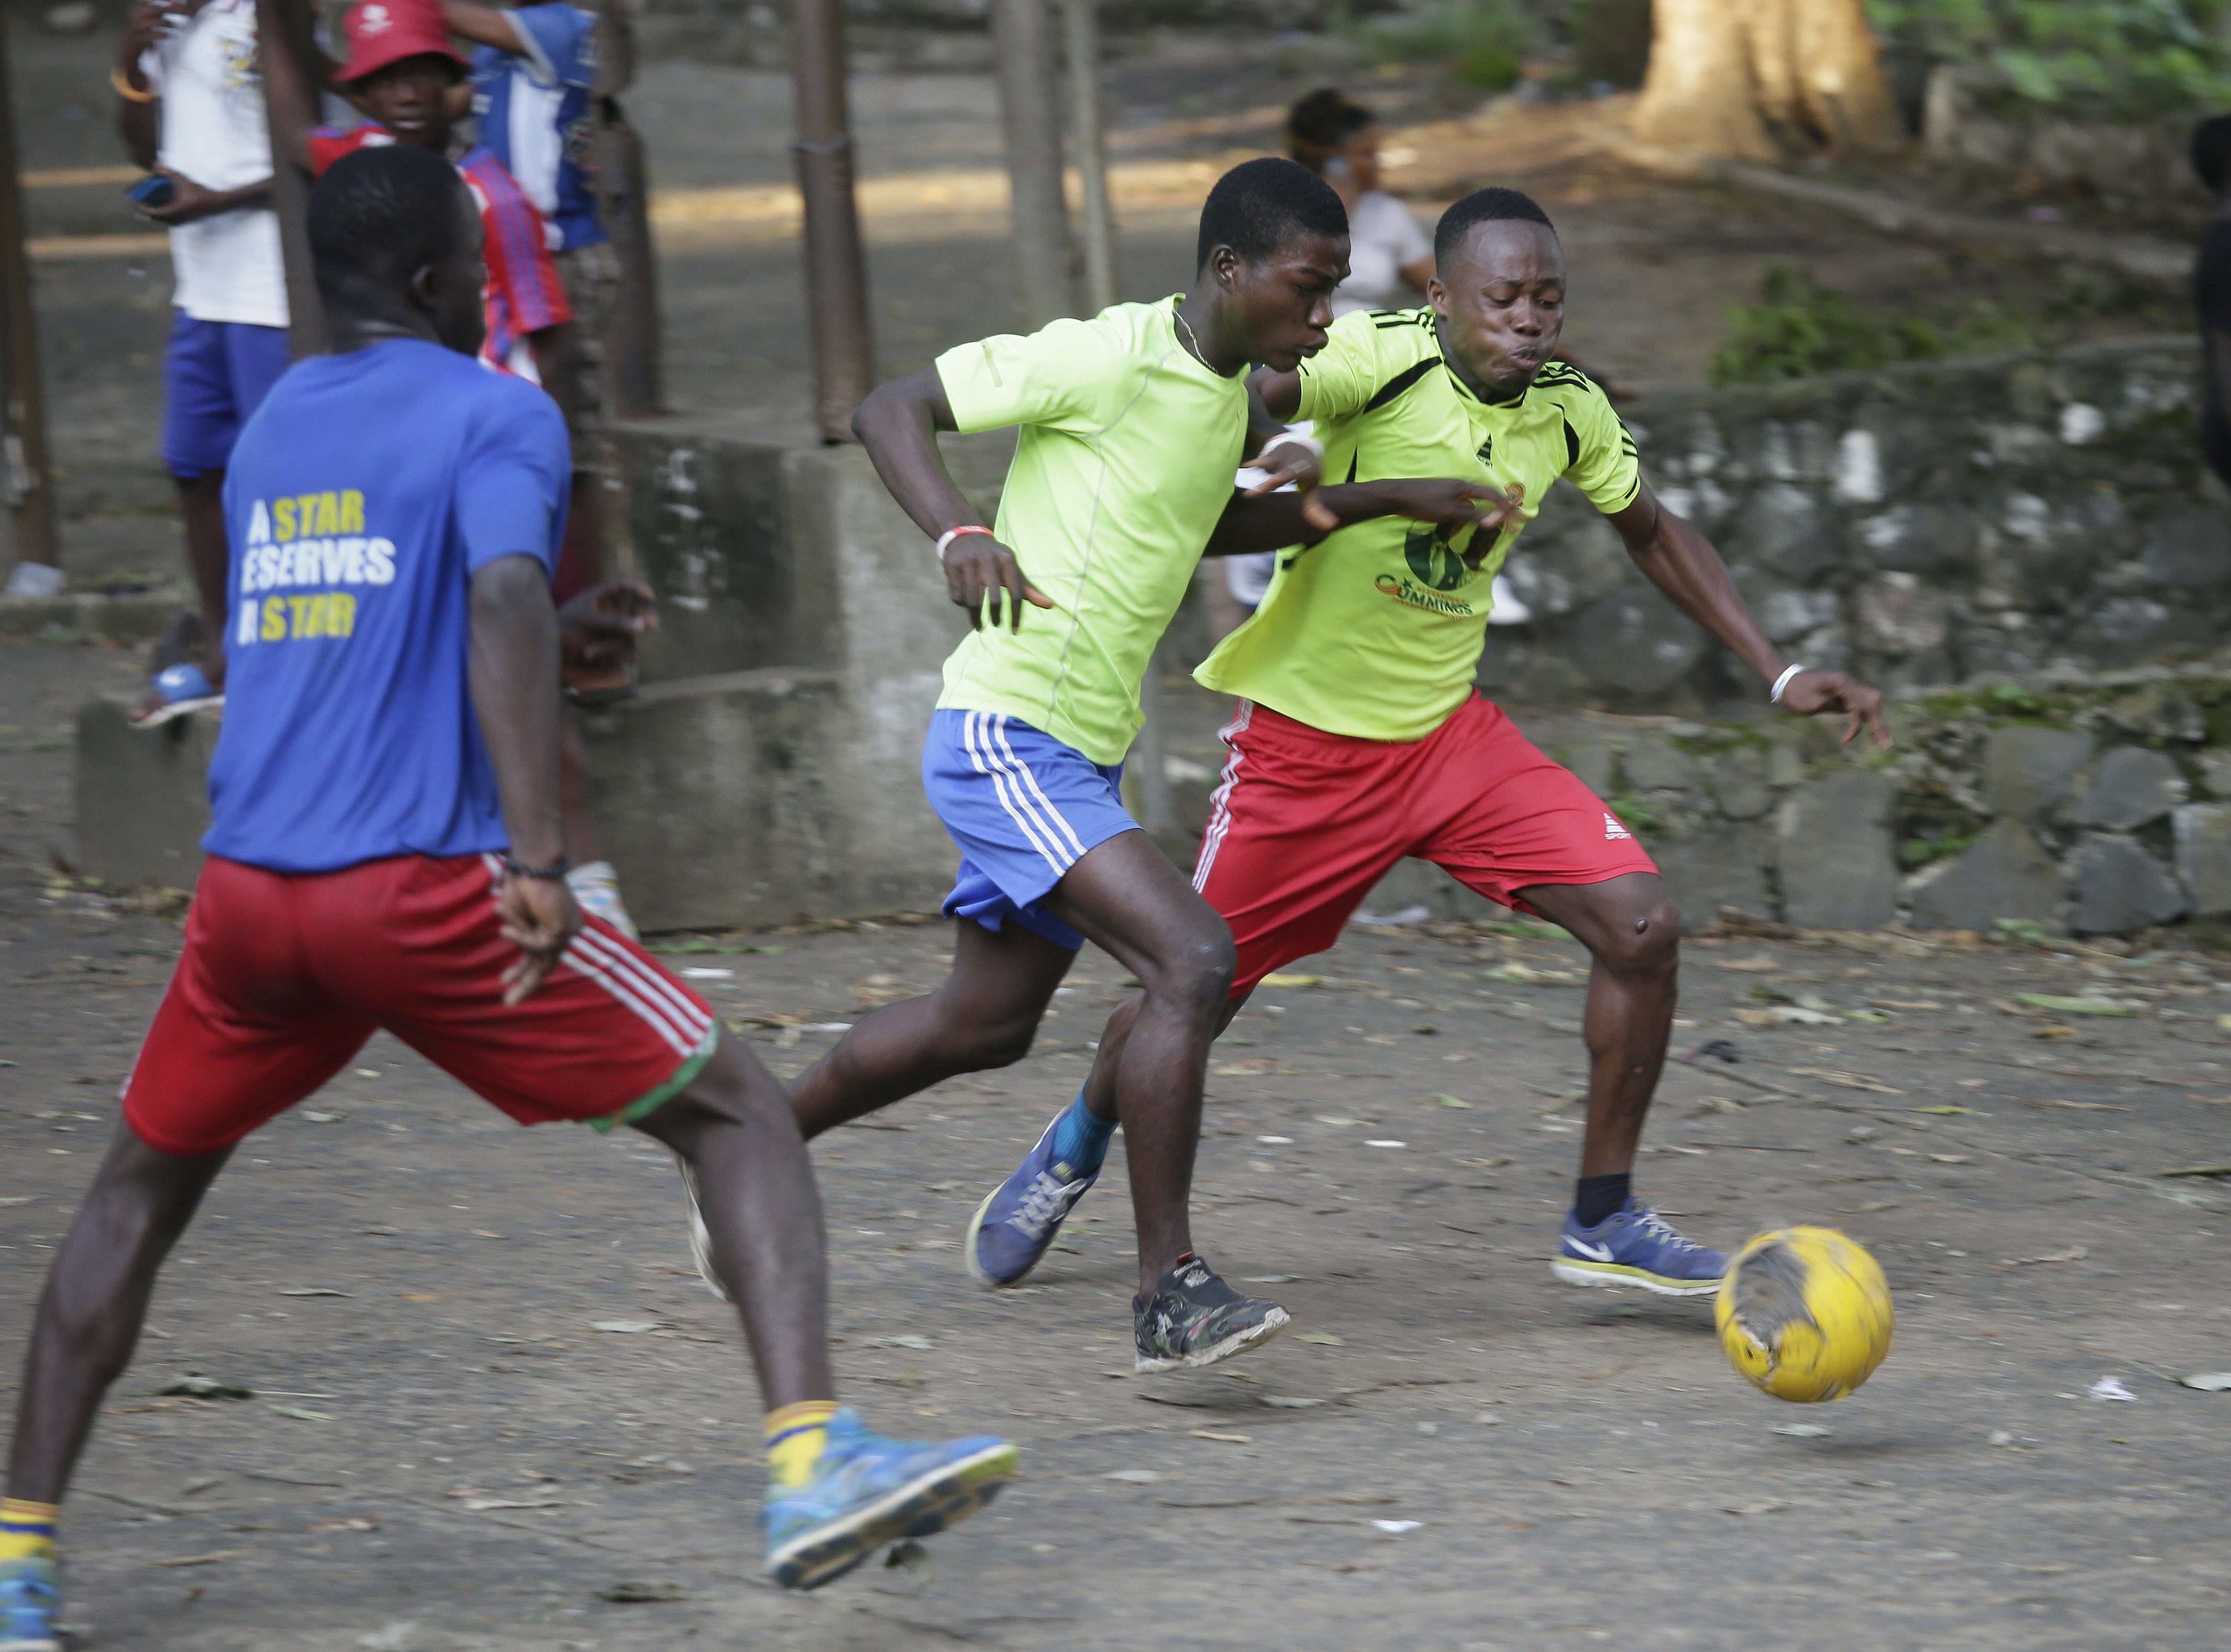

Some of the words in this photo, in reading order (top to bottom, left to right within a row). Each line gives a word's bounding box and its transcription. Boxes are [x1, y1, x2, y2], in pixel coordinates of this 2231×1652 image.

[247, 499, 271, 545] A
[273, 488, 365, 543] STAR
[241, 536, 397, 594] ESERVES
[260, 591, 357, 642] STAR
